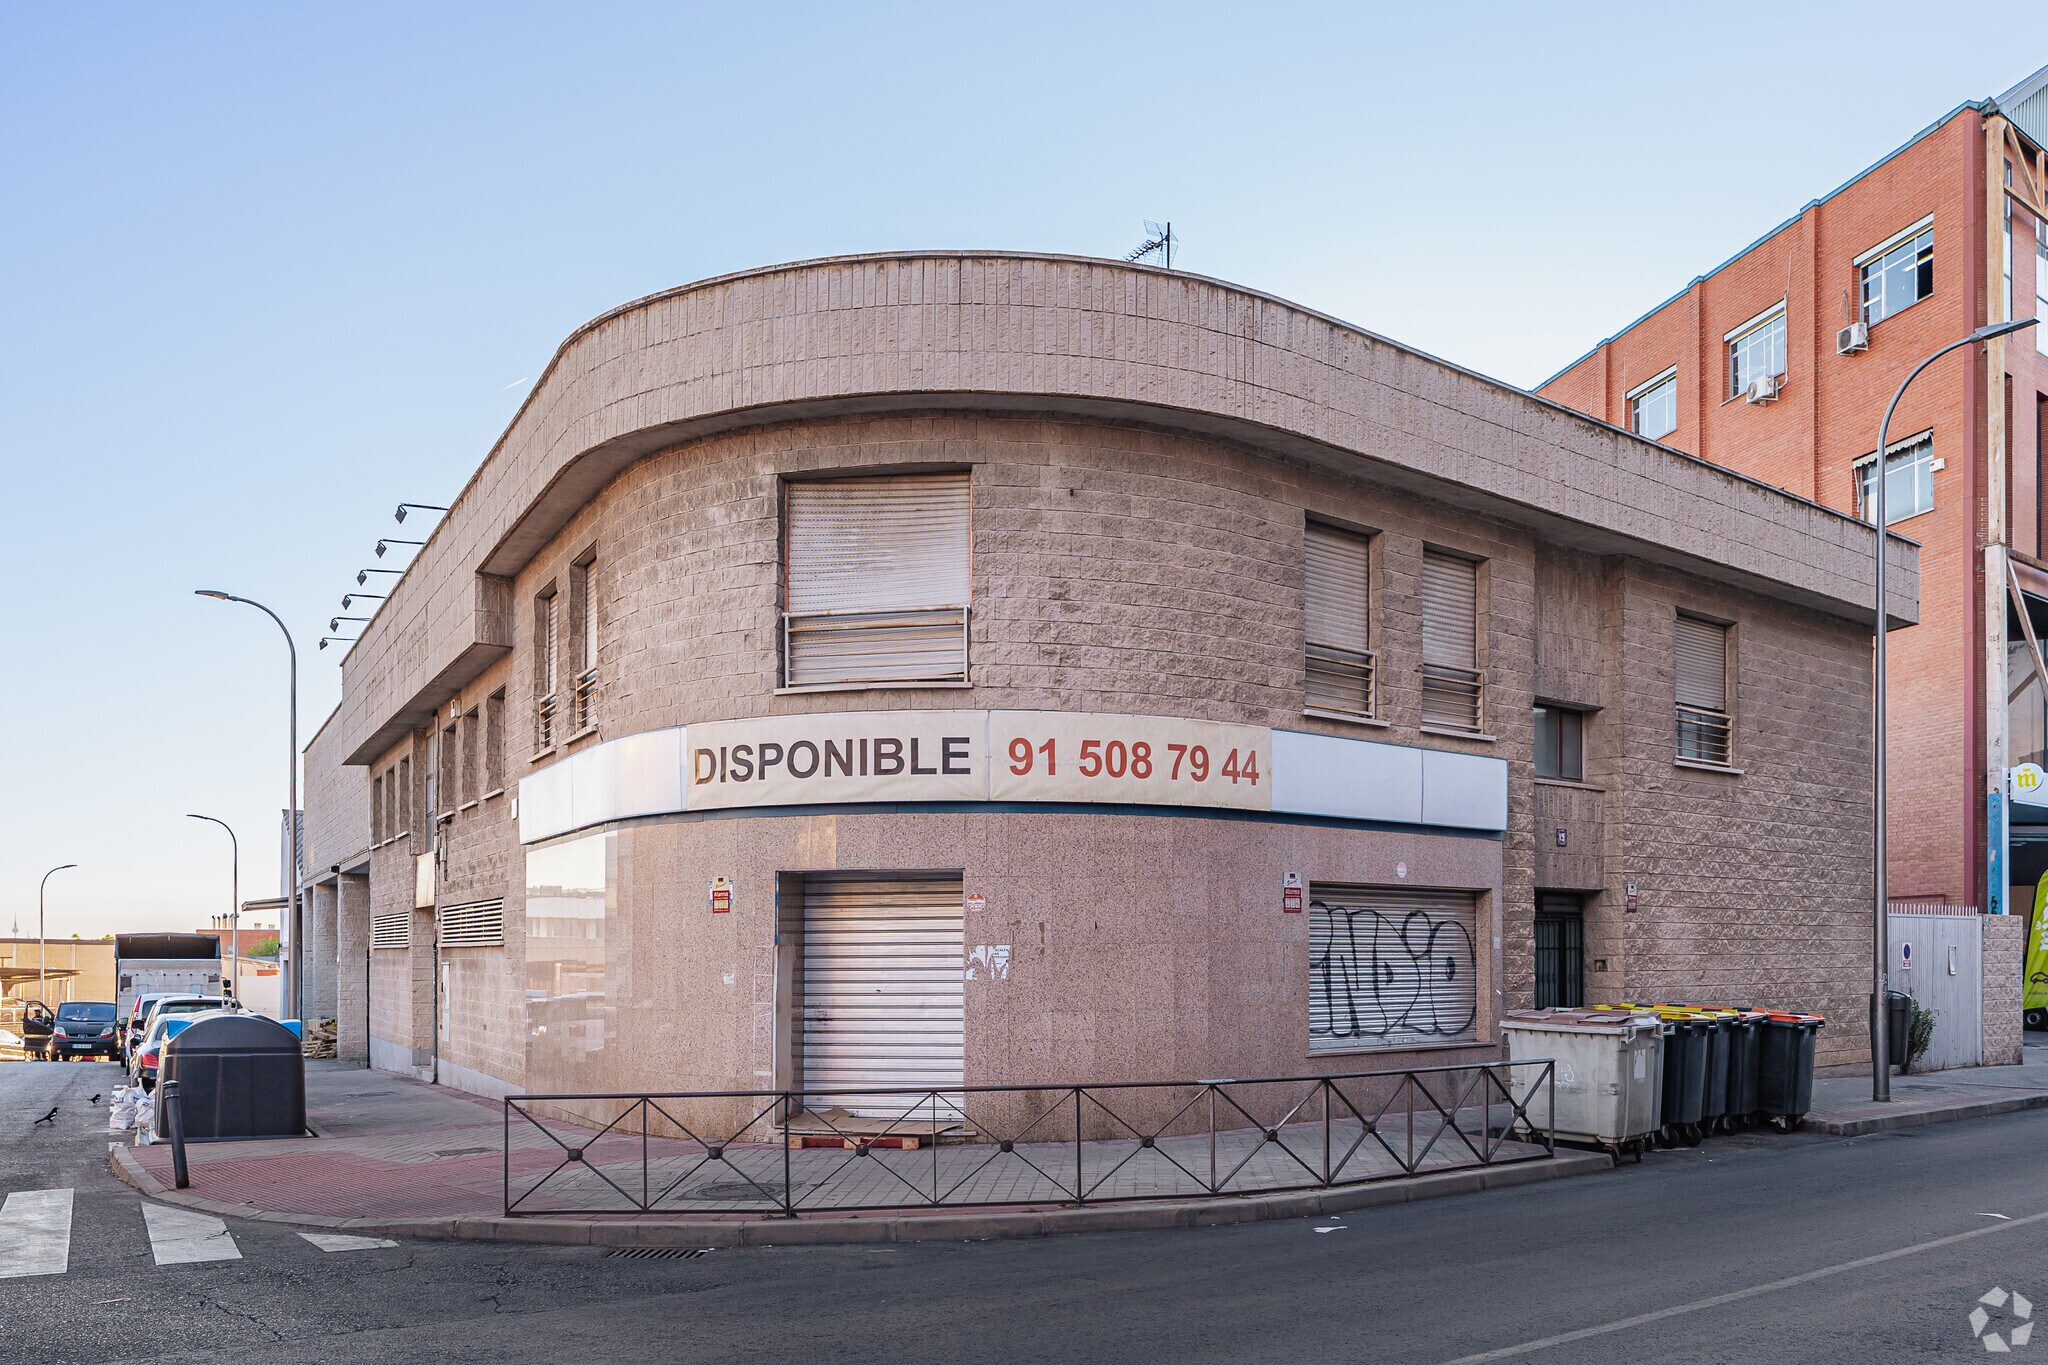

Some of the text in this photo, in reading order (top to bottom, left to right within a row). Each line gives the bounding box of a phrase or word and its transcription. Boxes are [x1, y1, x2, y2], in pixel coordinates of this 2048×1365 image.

[694, 736, 971, 786] DISPONIBLE
[1008, 737, 1260, 786] 91 508 79 44
